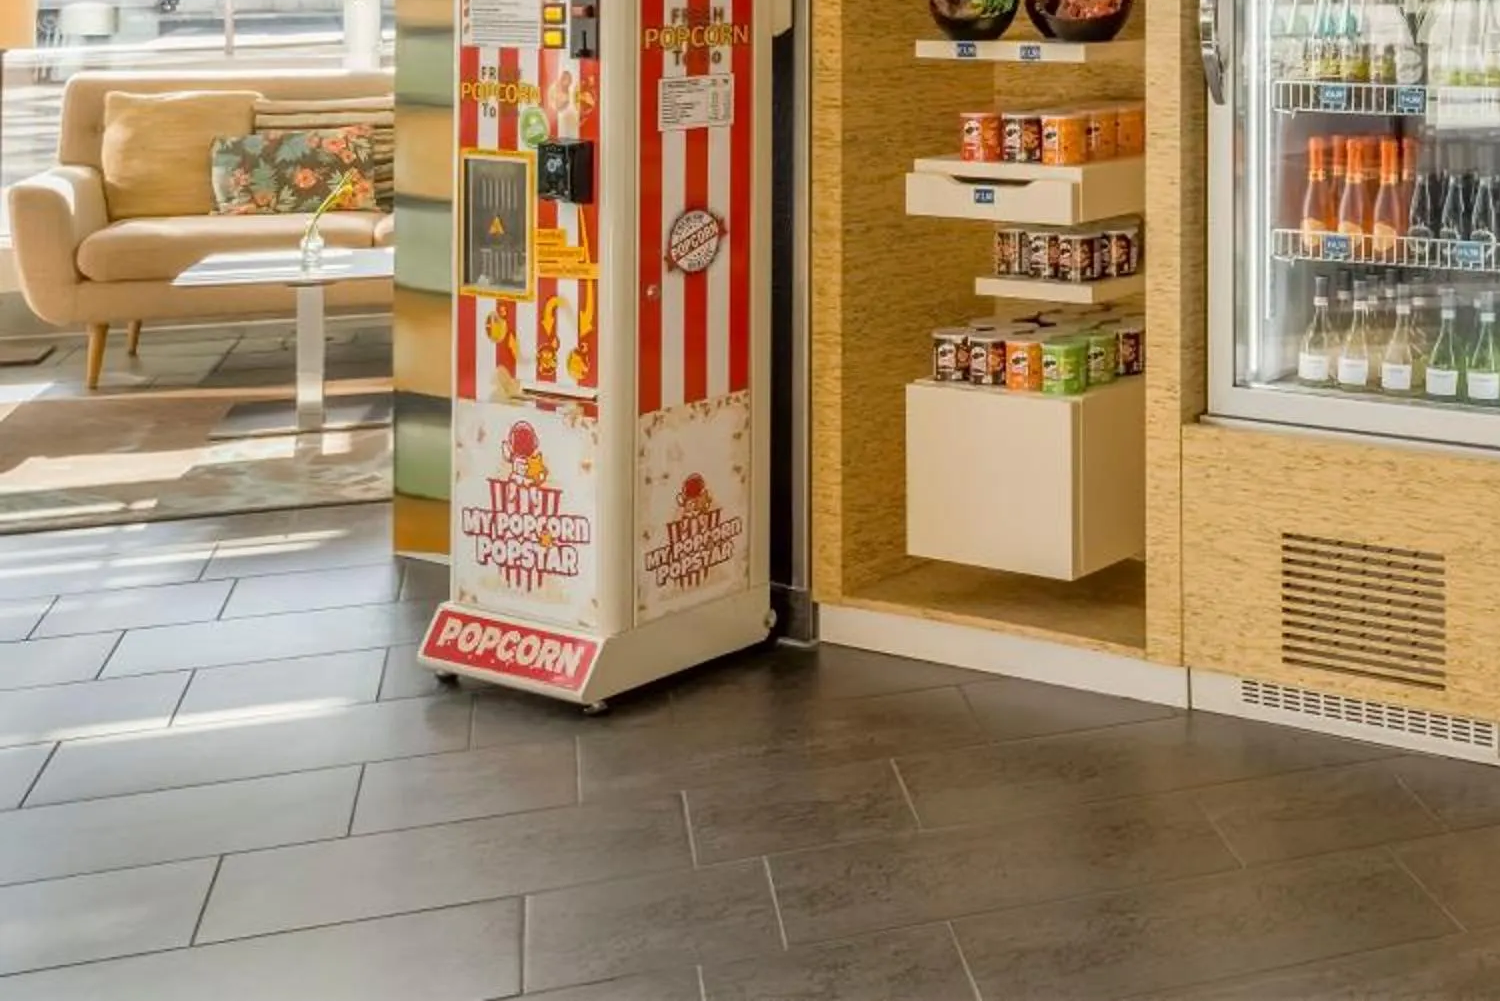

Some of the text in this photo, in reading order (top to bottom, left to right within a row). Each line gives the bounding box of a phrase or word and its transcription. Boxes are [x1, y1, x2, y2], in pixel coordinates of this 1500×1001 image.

[644, 24, 750, 50] POPCORN
[462, 507, 591, 544] MY POPCORN
[475, 535, 579, 577] POPSTAR
[656, 540, 735, 587] POPSTAR
[436, 616, 585, 678] POPCORN
